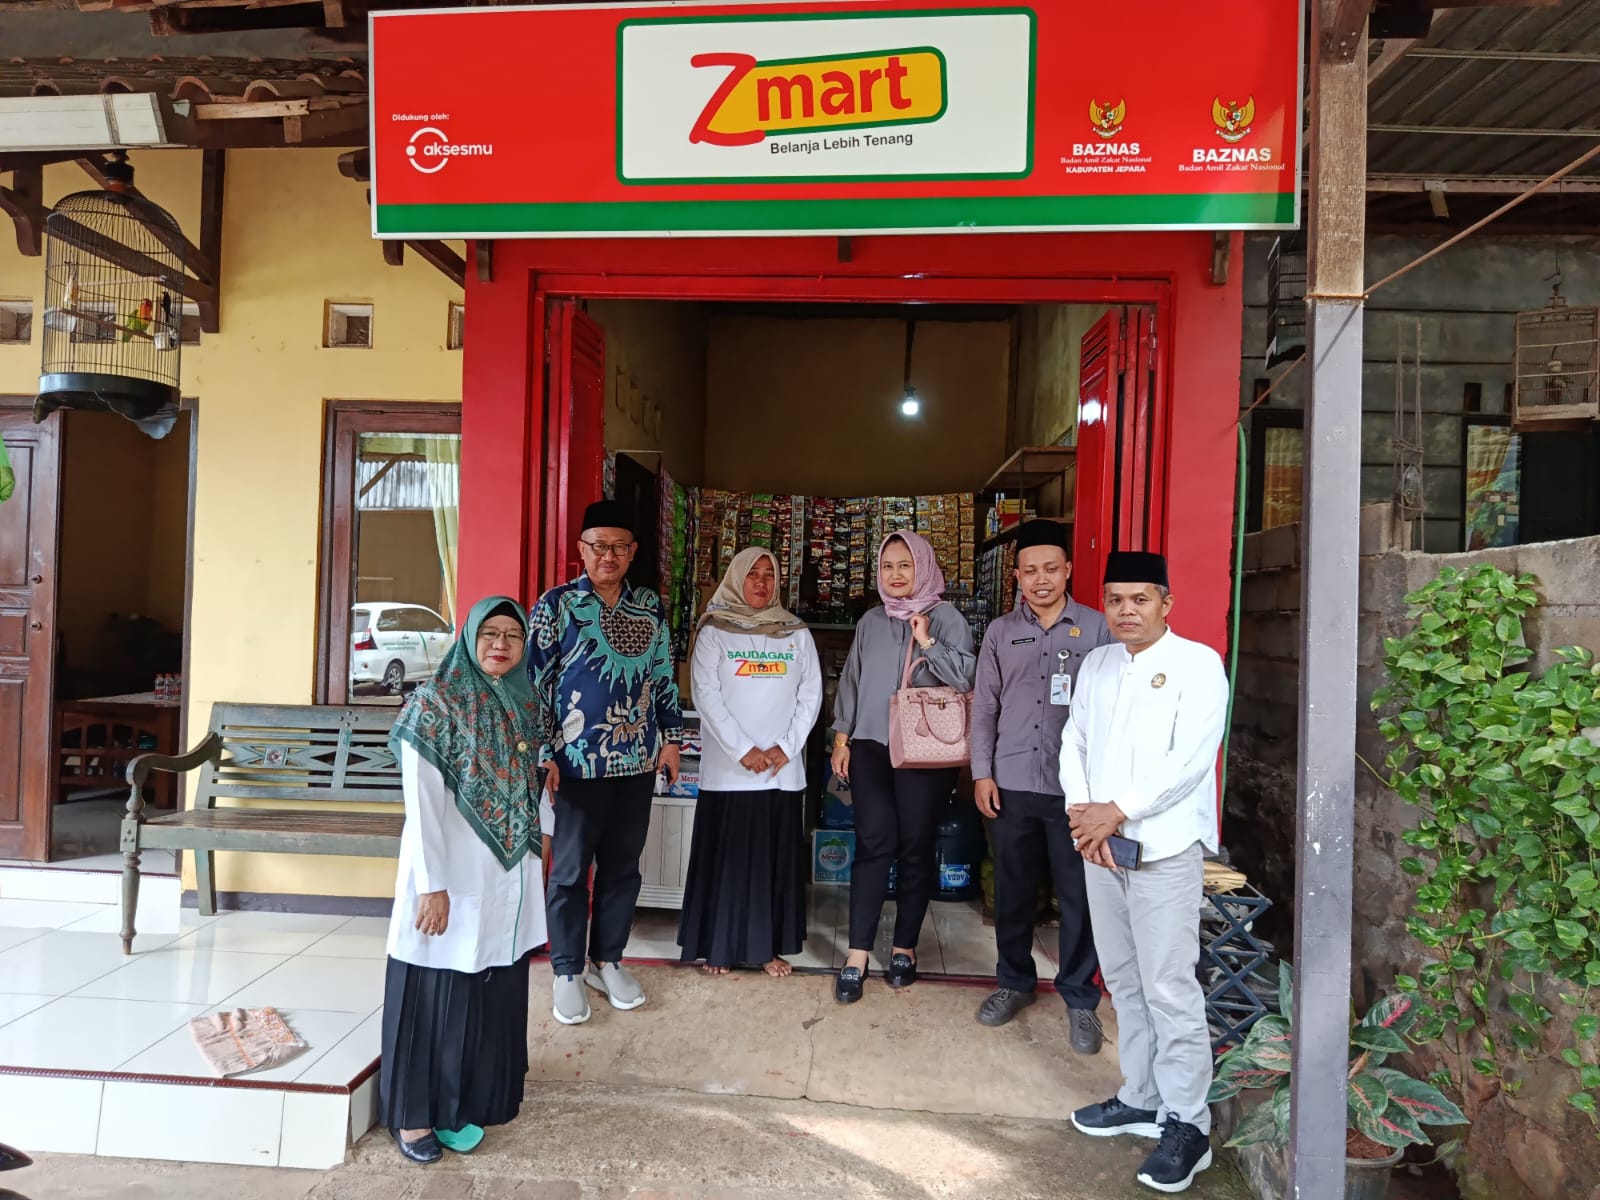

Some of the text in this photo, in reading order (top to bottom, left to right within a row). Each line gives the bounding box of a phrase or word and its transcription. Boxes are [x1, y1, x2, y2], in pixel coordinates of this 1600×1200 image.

[689, 53, 912, 146] Zmart
[392, 114, 429, 122] Didukung
[423, 142, 493, 156] aksesmu
[770, 133, 913, 154] Belanja Lebih Tenang
[1072, 143, 1140, 156] BAZNAS
[1193, 148, 1271, 162] BAZNAS
[1066, 165, 1146, 174] KABUPATEN JEPARA
[1178, 164, 1203, 172] Badan
[1225, 163, 1248, 171] Zakat
[727, 650, 794, 661] SAUDAGAR
[735, 659, 780, 676] Zmart
